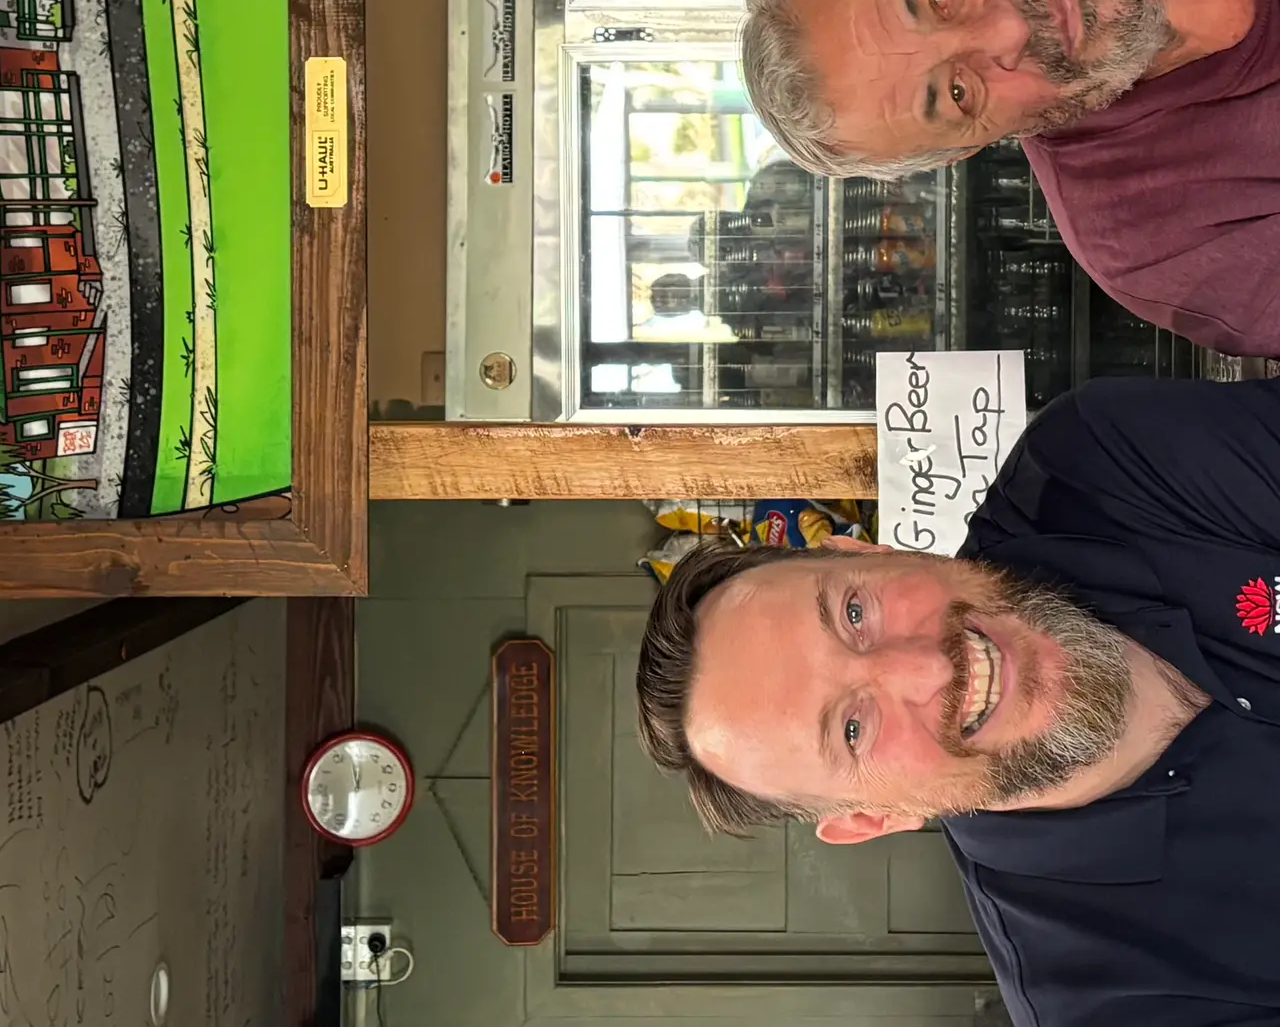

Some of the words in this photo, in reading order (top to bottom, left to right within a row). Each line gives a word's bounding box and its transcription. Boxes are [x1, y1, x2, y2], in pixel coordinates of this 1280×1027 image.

[503, 40, 514, 81] ILLABO
[502, 94, 513, 134] HOTEL
[502, 142, 513, 183] ILLABO
[885, 349, 933, 434] Beer
[952, 386, 1001, 473] Tap
[896, 438, 962, 553] Ginger
[511, 661, 539, 802] KNOWLEDGE
[511, 811, 538, 839] OF
[511, 846, 539, 922] HOUSE
